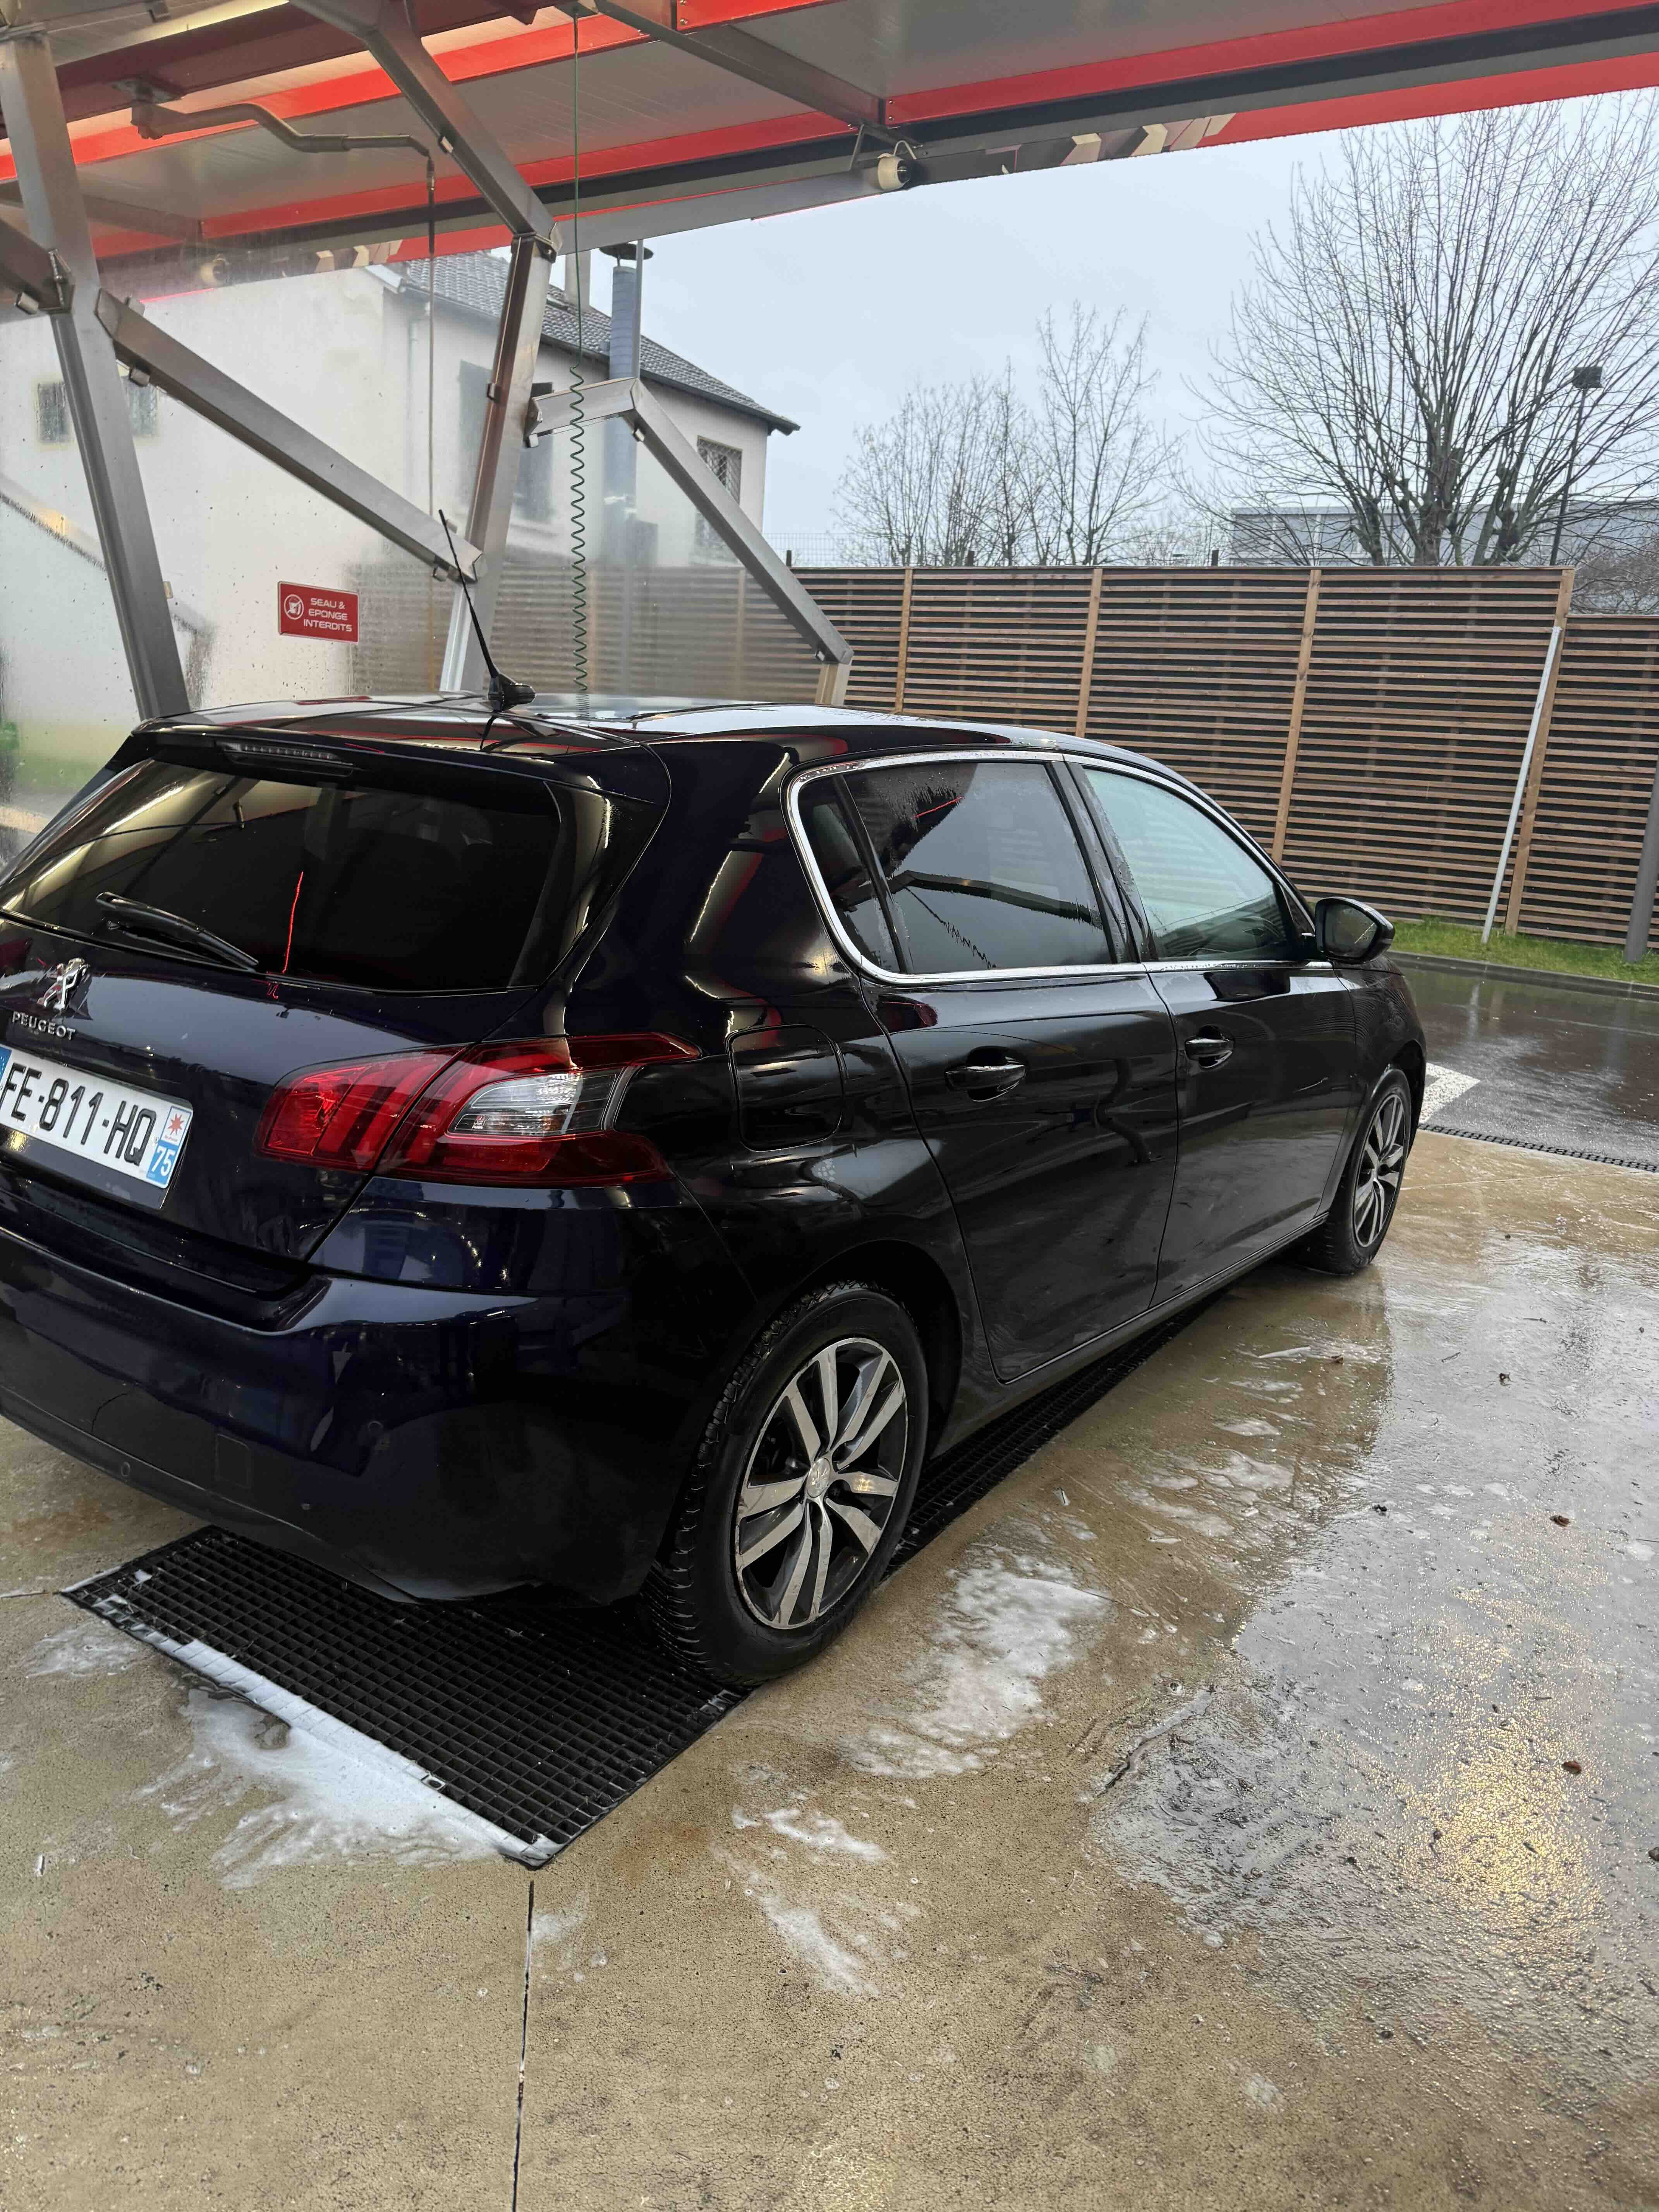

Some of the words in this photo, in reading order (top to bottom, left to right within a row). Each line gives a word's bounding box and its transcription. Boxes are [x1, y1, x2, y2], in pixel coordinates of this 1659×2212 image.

[308, 608, 348, 620] EPONGE
[311, 598, 337, 608] SEAU
[338, 601, 345, 609] &
[304, 618, 352, 632] INTERDITS
[12, 1011, 76, 1041] PEUGEOT
[0, 1062, 157, 1166] FE-811-HQ
[151, 1145, 176, 1176] 75
